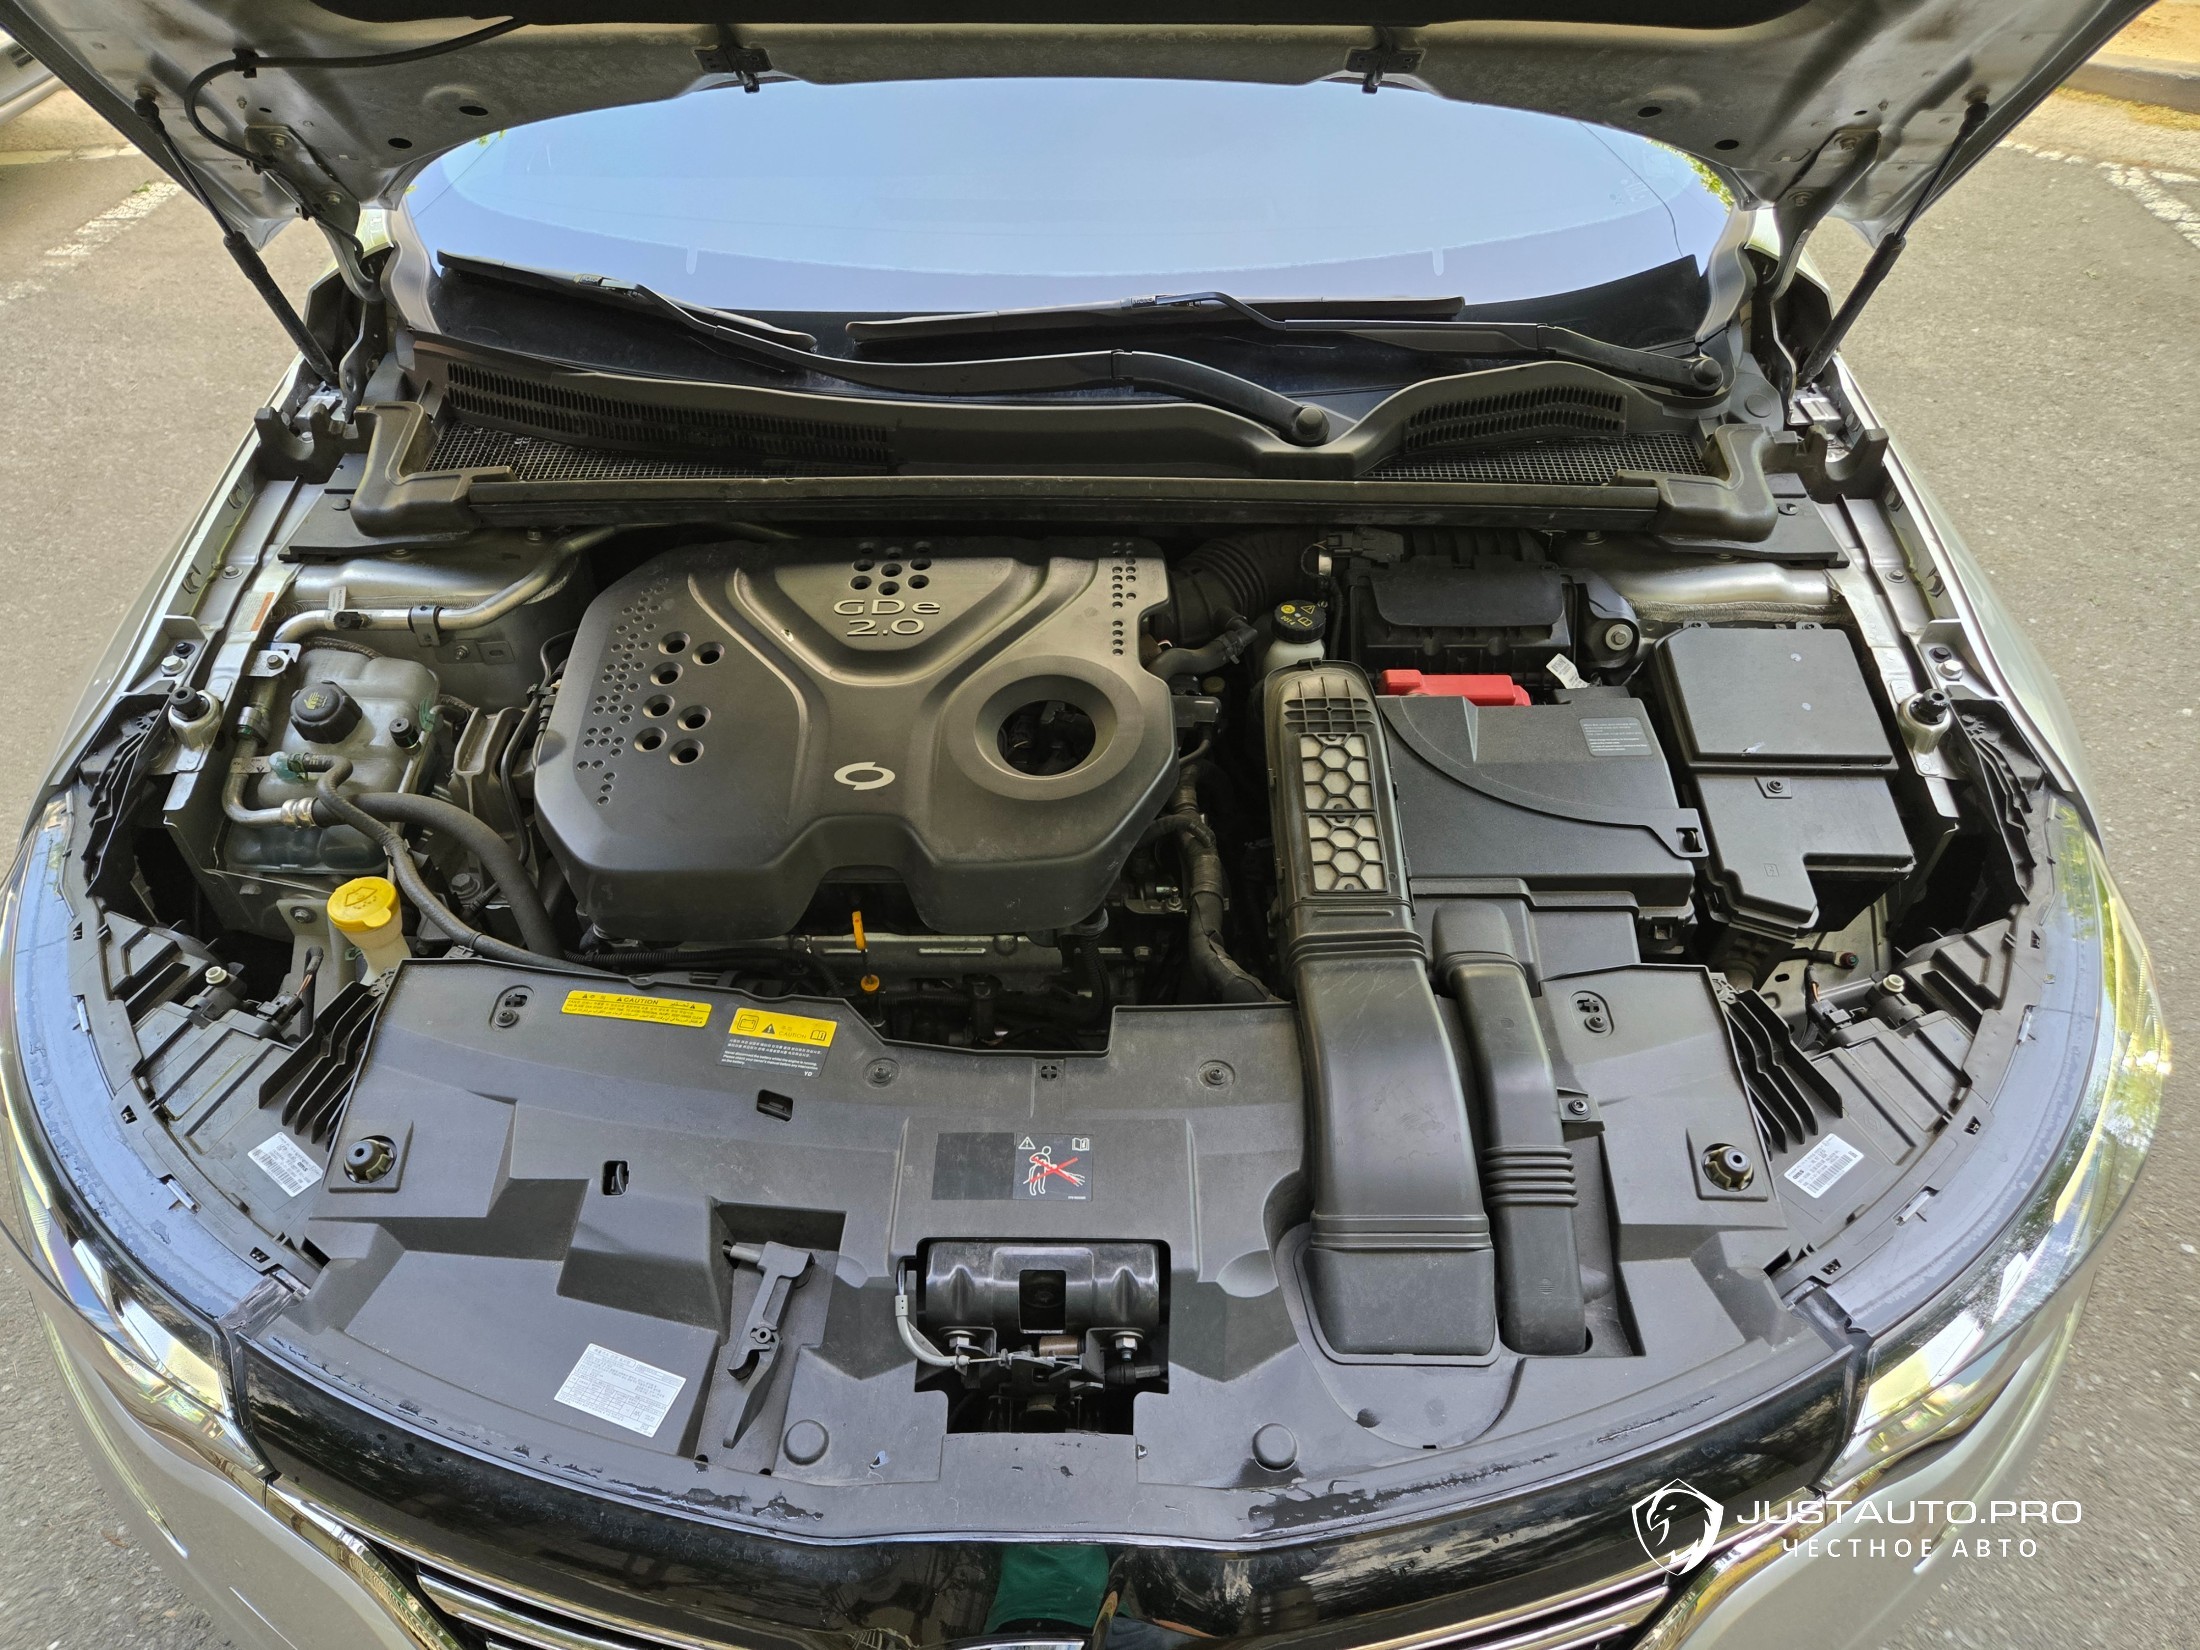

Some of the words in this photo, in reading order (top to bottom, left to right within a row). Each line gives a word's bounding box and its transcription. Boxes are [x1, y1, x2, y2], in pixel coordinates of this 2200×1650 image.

[833, 599, 941, 616] GDe
[846, 618, 925, 637] 2.0
[623, 997, 659, 1005] CAUTION
[778, 1030, 807, 1039] CAUTION
